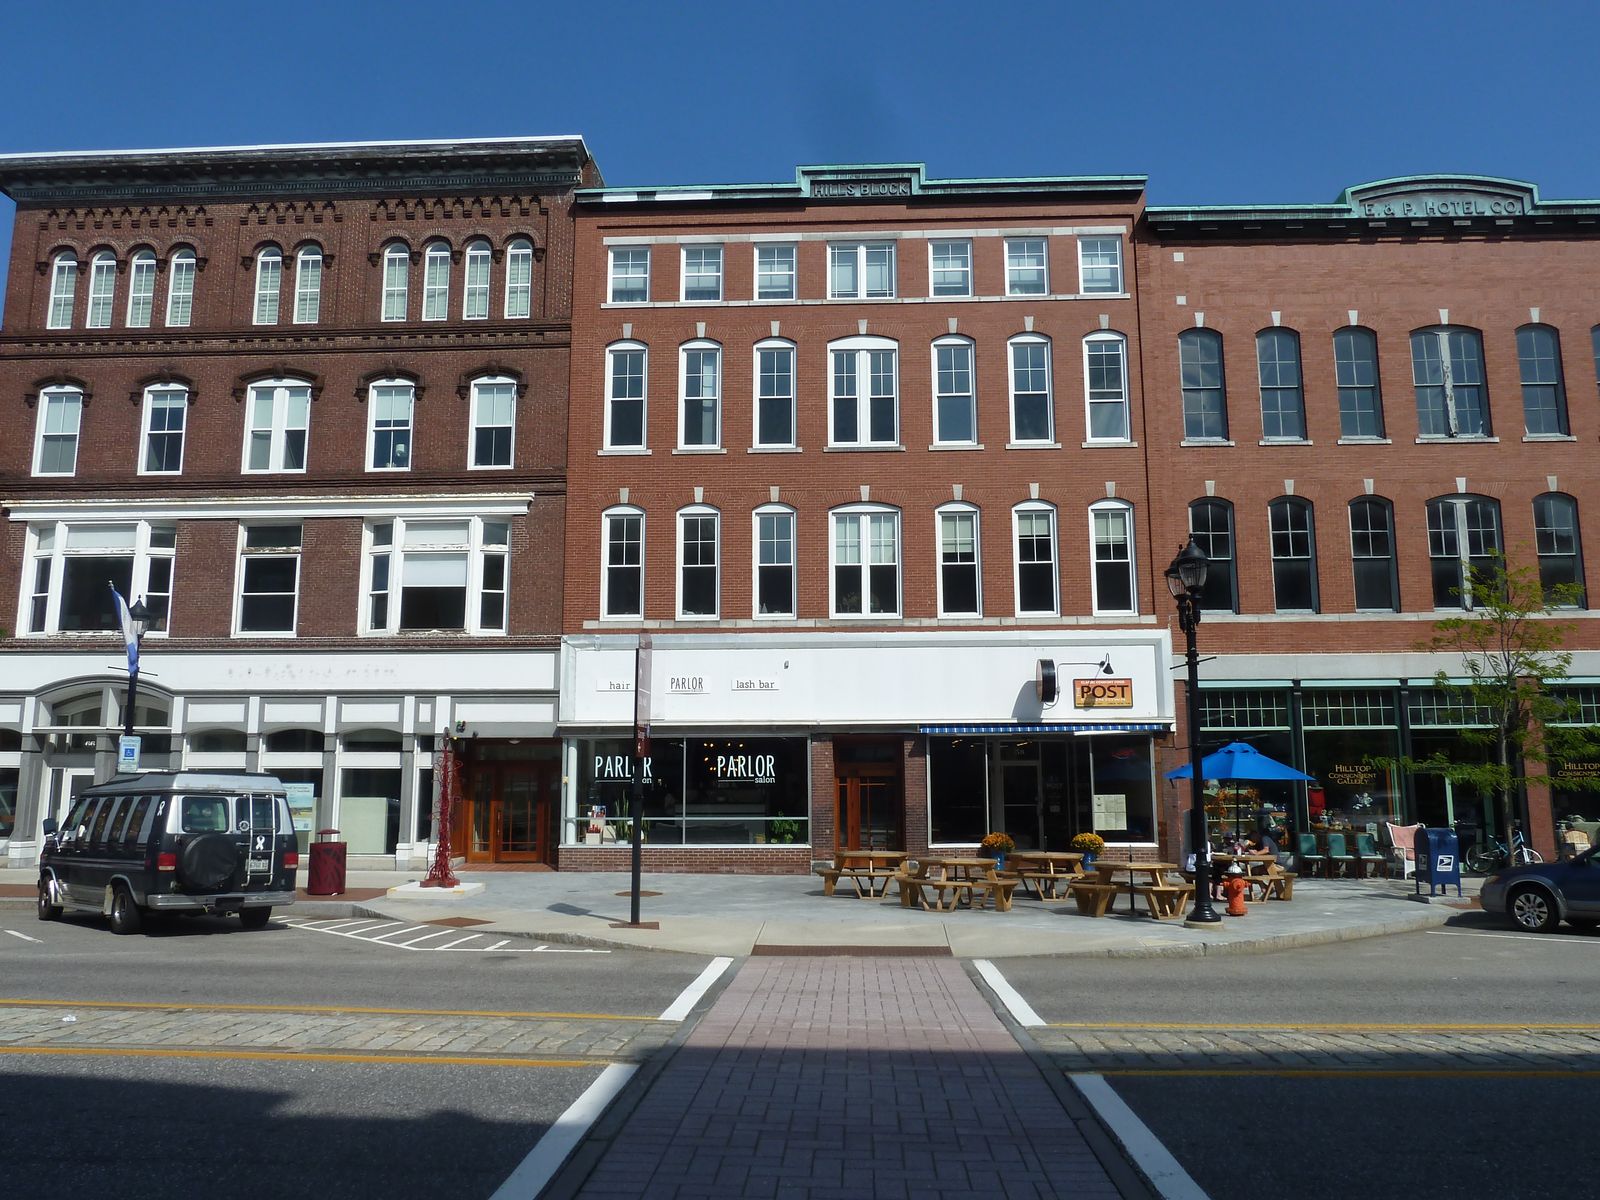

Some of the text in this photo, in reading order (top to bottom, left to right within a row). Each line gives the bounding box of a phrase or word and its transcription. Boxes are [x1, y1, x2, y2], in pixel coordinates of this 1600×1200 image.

[814, 182, 909, 197] HILLS BLOCK
[1425, 201, 1486, 216] HOTEL
[1490, 200, 1522, 215] CO.
[609, 681, 631, 690] hair
[670, 677, 704, 690] PARLOR
[736, 680, 775, 689] lash bar
[1080, 684, 1129, 699] POST
[594, 755, 653, 778] PARLR
[717, 755, 776, 778] PARLOR
[754, 776, 776, 784] salon
